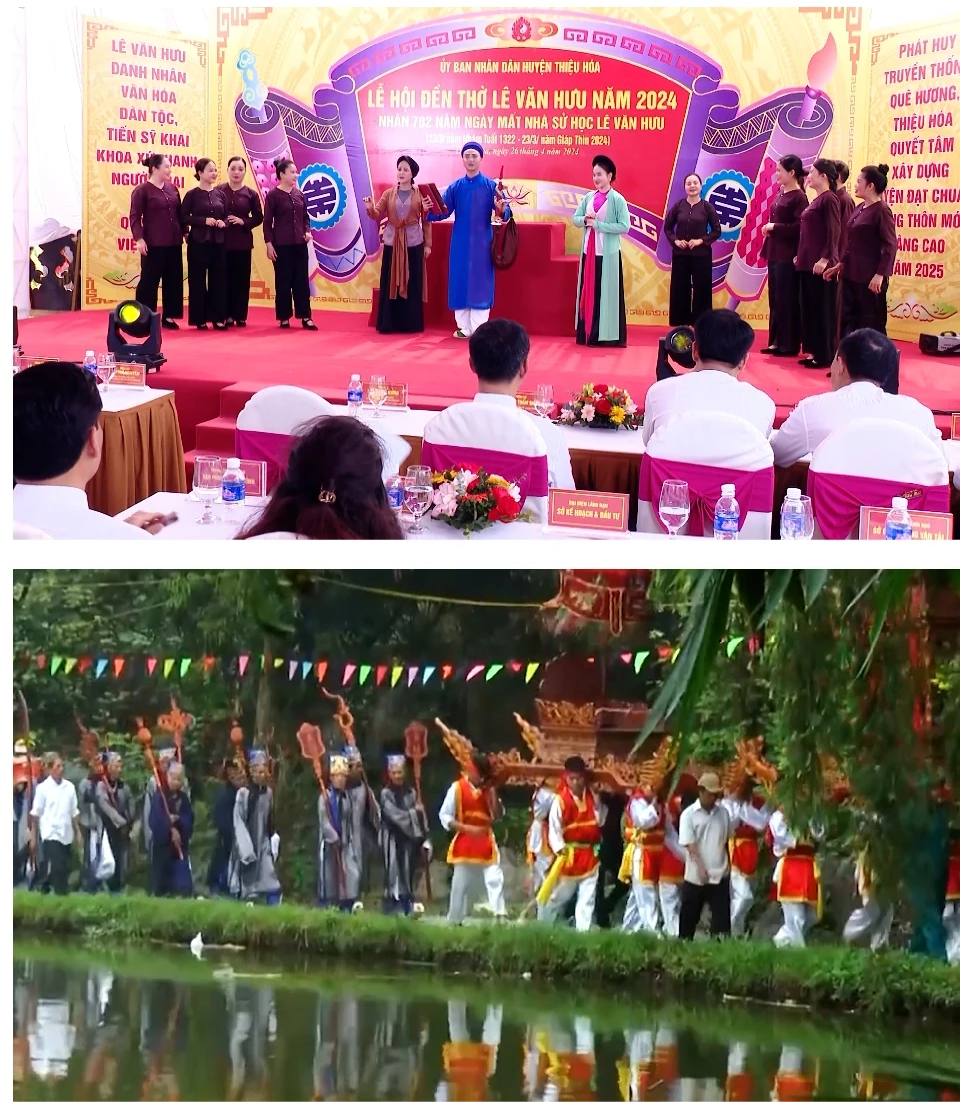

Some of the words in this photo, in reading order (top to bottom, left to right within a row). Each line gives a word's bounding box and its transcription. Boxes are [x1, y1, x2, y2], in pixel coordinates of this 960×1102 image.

[111, 39, 126, 53] LÊ
[131, 42, 157, 58] VĂN
[161, 47, 186, 63] HƯU
[899, 38, 929, 58] PHÁT
[931, 34, 957, 52] HUY
[111, 61, 147, 79] DANH
[151, 68, 187, 84] NHÂN
[440, 58, 451, 73] ỦY
[453, 61, 472, 73] BAN
[474, 59, 498, 73] NHÂN
[501, 59, 520, 73] DÂN
[522, 59, 552, 75] HUYỆN
[555, 59, 578, 75] THIỆU
[582, 59, 600, 73] HÓA
[884, 61, 926, 85] TRUYỀN
[930, 54, 960, 78] THỐN
[152, 88, 177, 104] HÓA
[368, 83, 385, 108] LỄ
[390, 86, 415, 112] HỘI
[420, 84, 452, 108] ĐỀN
[457, 86, 487, 109] THỜ
[492, 86, 511, 109] LÊ
[515, 86, 548, 109] VĂN
[554, 88, 587, 110] HƯU
[592, 86, 631, 110] NĂM
[636, 90, 678, 110] 2024
[890, 89, 911, 109] QUÊ
[915, 85, 960, 105] HƯƠNG,
[151, 109, 178, 127] TỘC,
[435, 113, 461, 128] NĂM
[464, 113, 494, 129] NGÀY
[497, 111, 522, 129] MẤT
[524, 114, 548, 129] NHÀ
[552, 113, 568, 129] SỬ
[570, 115, 595, 132] HỌC
[597, 115, 610, 130] LÊ
[613, 115, 637, 130] VĂN
[640, 116, 665, 130] HƯU
[893, 113, 925, 133] THIỆU
[928, 110, 953, 129] HÓA
[106, 125, 136, 143] TIẾN
[160, 132, 190, 148] KHAI
[499, 134, 516, 144] 1322
[541, 135, 556, 145] năm
[890, 135, 924, 156] QUYẾT
[928, 135, 954, 154] TÂM
[96, 149, 132, 164] KHOA
[511, 147, 519, 155] 26
[111, 171, 148, 186] NGƯỜ
[891, 162, 914, 179] XÂY
[916, 162, 949, 182] DỰNG
[907, 189, 928, 206] ĐẠT
[907, 211, 937, 228] THÔN
[117, 238, 138, 253] VIỆ
[896, 234, 918, 252] ÂNG
[922, 238, 945, 254] CAO
[892, 259, 912, 276] ĂM
[914, 262, 944, 279] 2025
